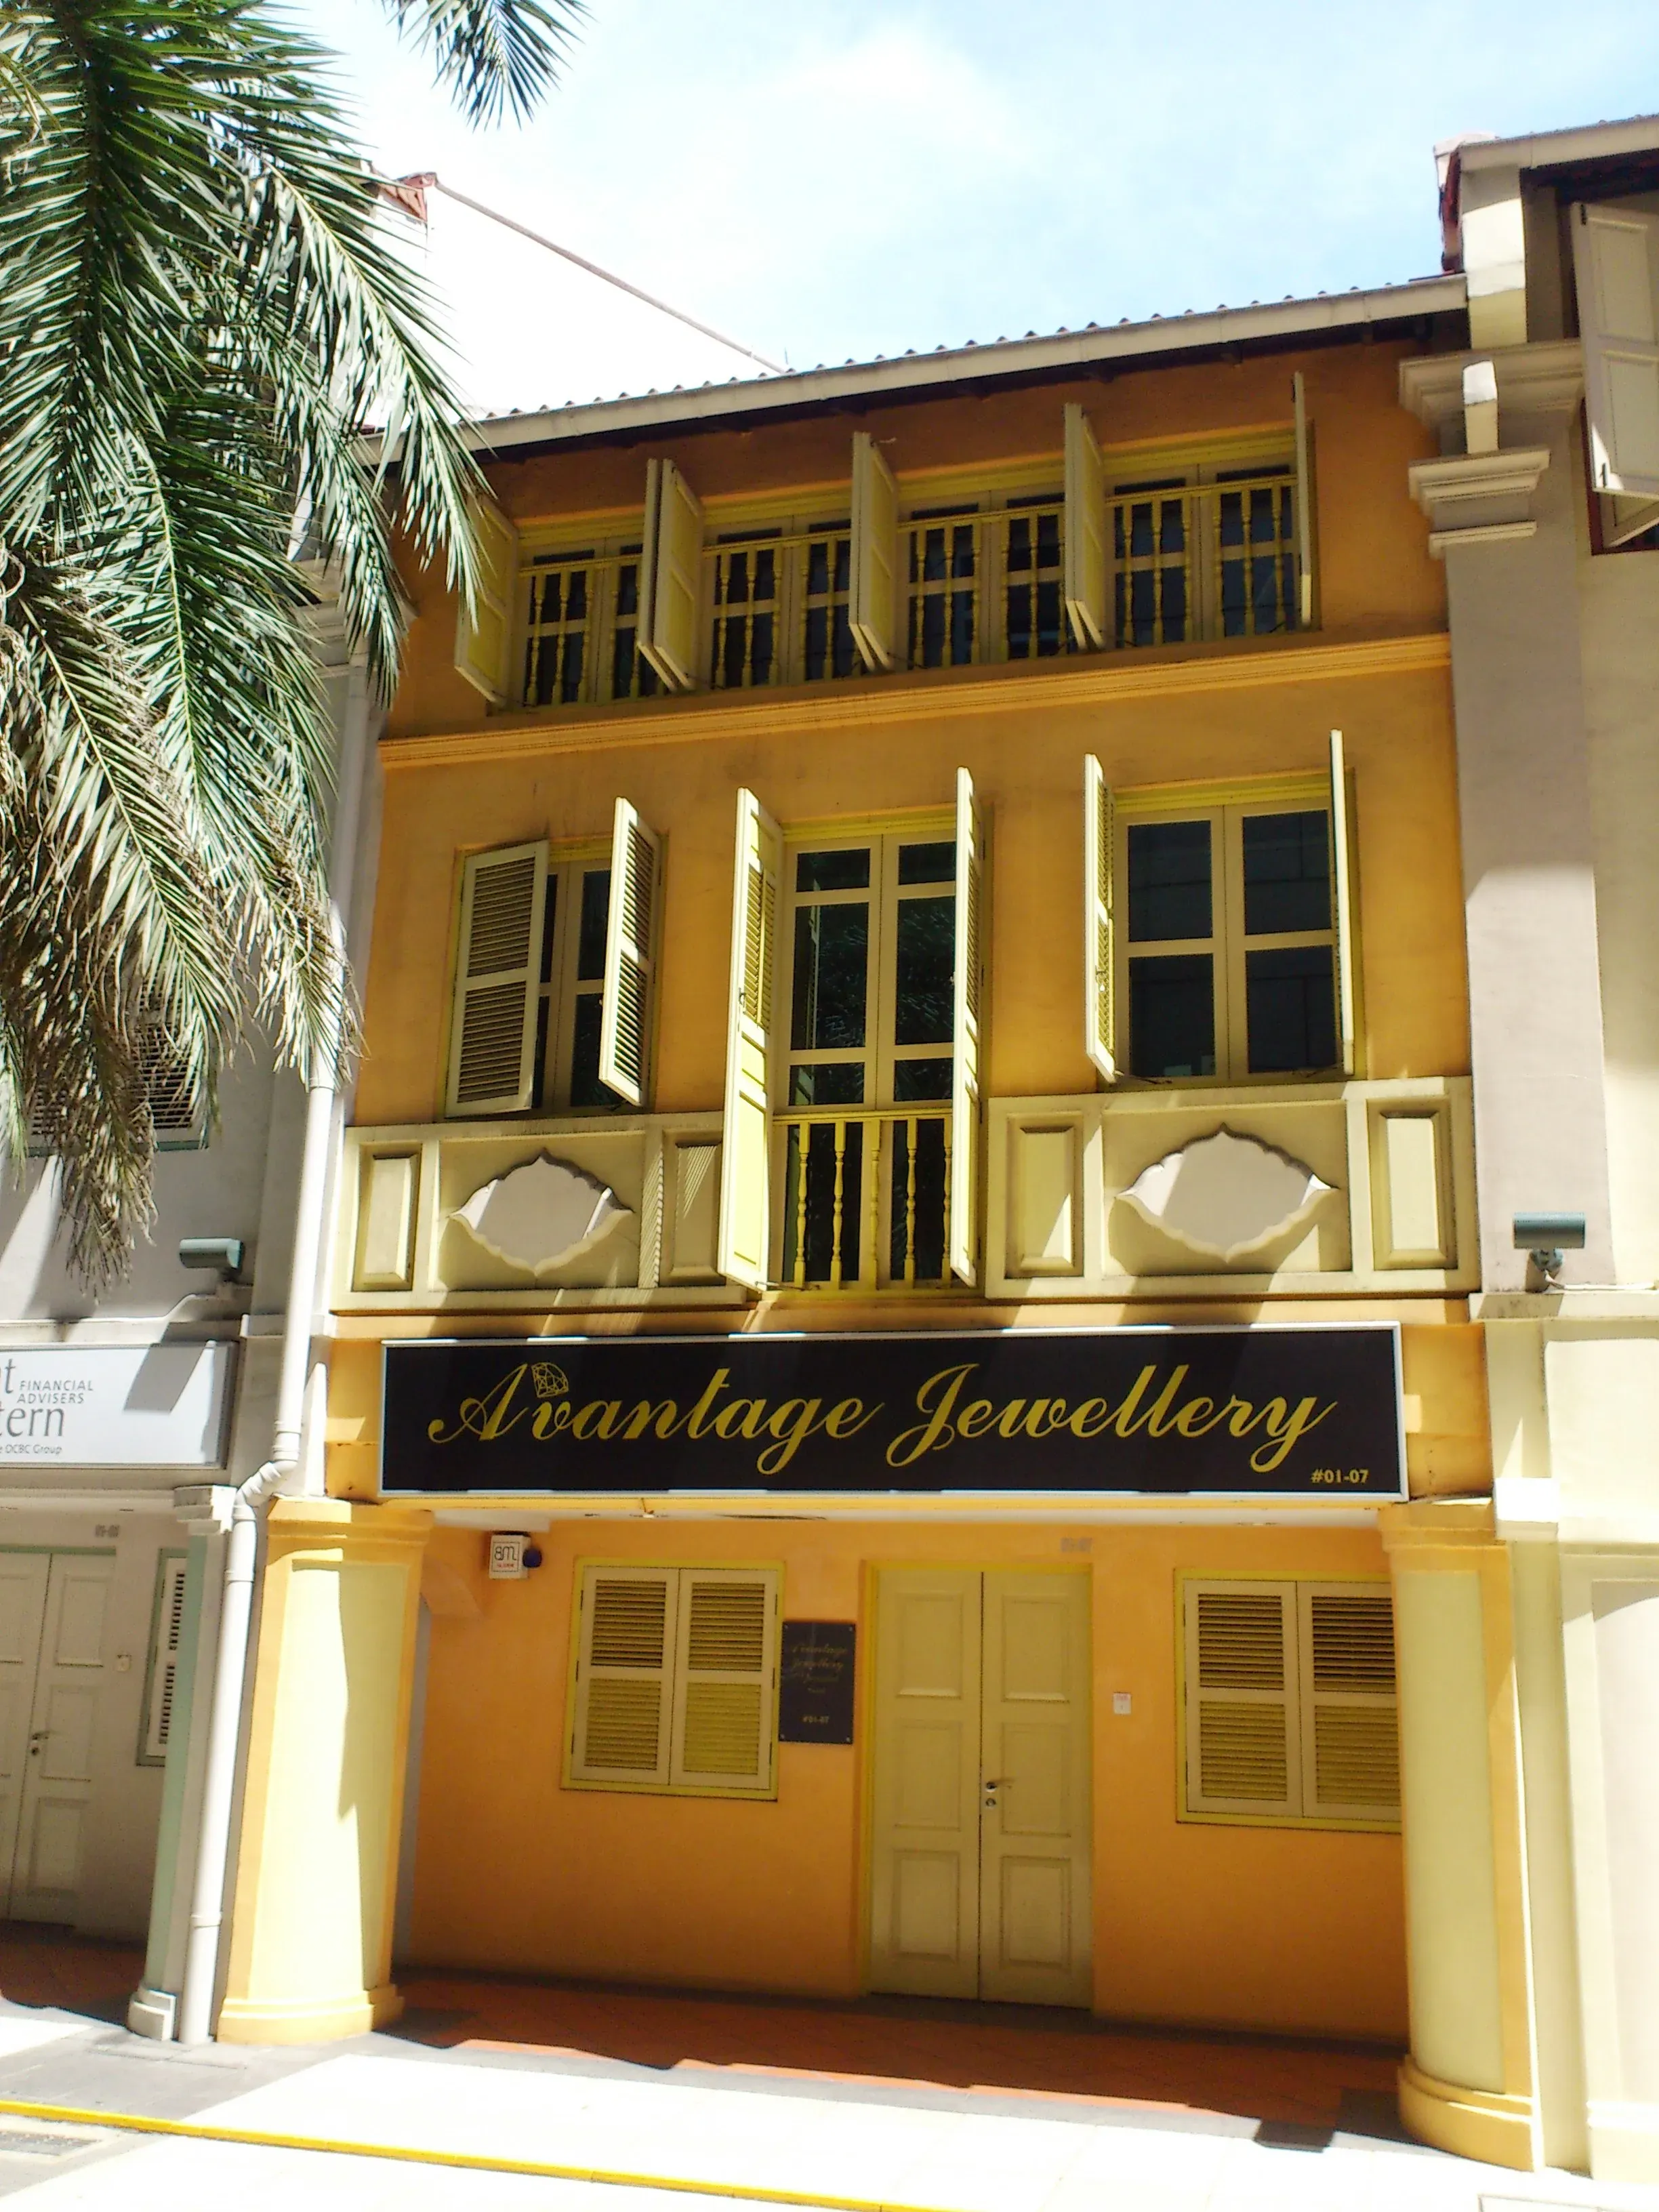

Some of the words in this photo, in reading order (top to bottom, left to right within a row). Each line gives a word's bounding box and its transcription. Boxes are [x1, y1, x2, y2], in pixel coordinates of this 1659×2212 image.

[19, 1380, 94, 1391] FINANCIAL
[17, 1393, 85, 1404] ADVISERS
[427, 1362, 885, 1475] Avantage
[886, 1363, 1338, 1473] Jewellery
[5, 1443, 30, 1454] OCBC
[33, 1444, 62, 1458] Group
[1310, 1469, 1369, 1483] #01-07
